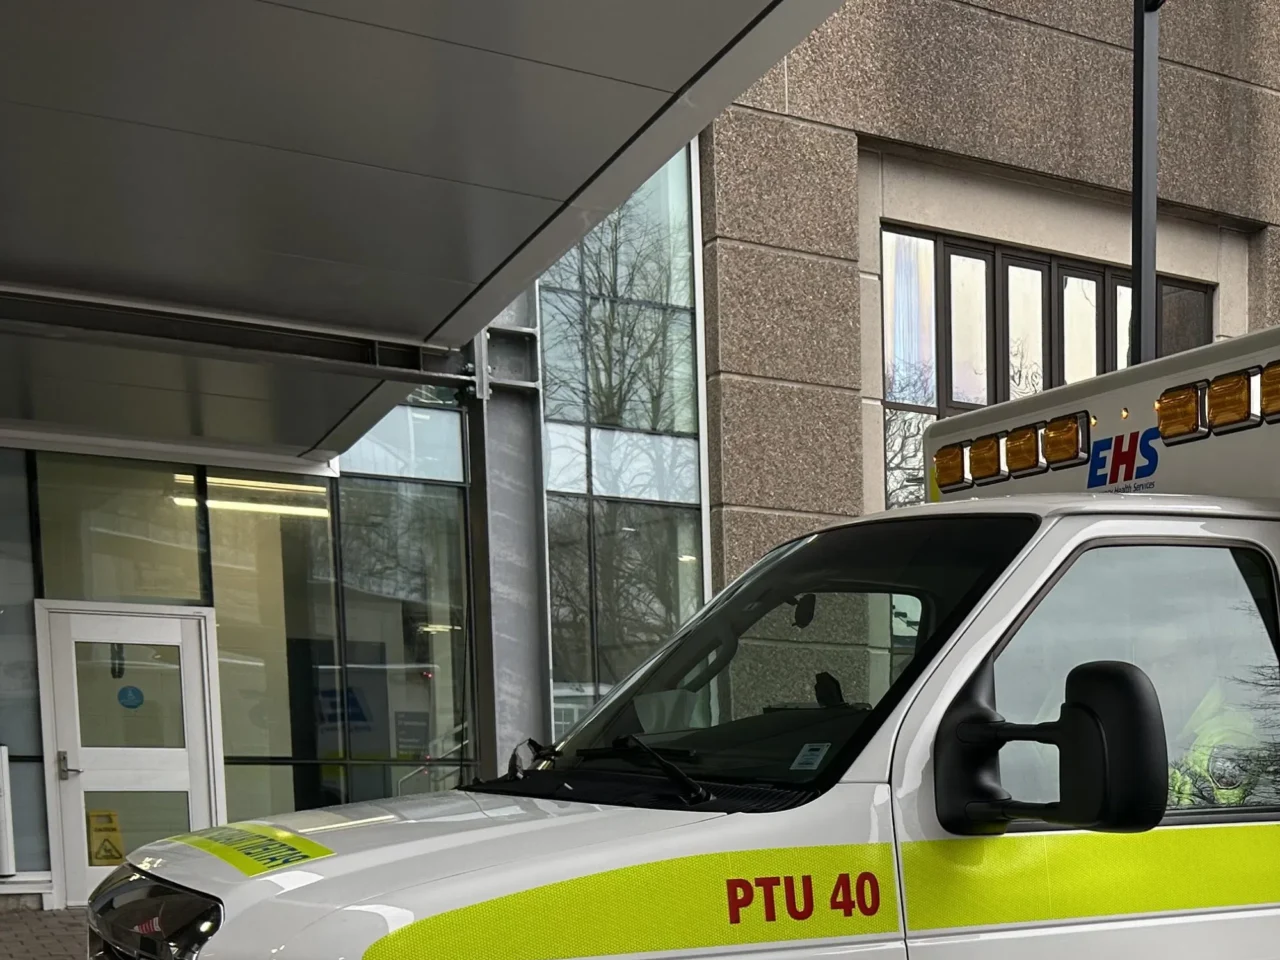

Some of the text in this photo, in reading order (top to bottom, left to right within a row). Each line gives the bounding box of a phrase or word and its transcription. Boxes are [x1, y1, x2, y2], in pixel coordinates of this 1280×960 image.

[1087, 426, 1161, 489] EHS
[726, 871, 880, 925] PTU 40
